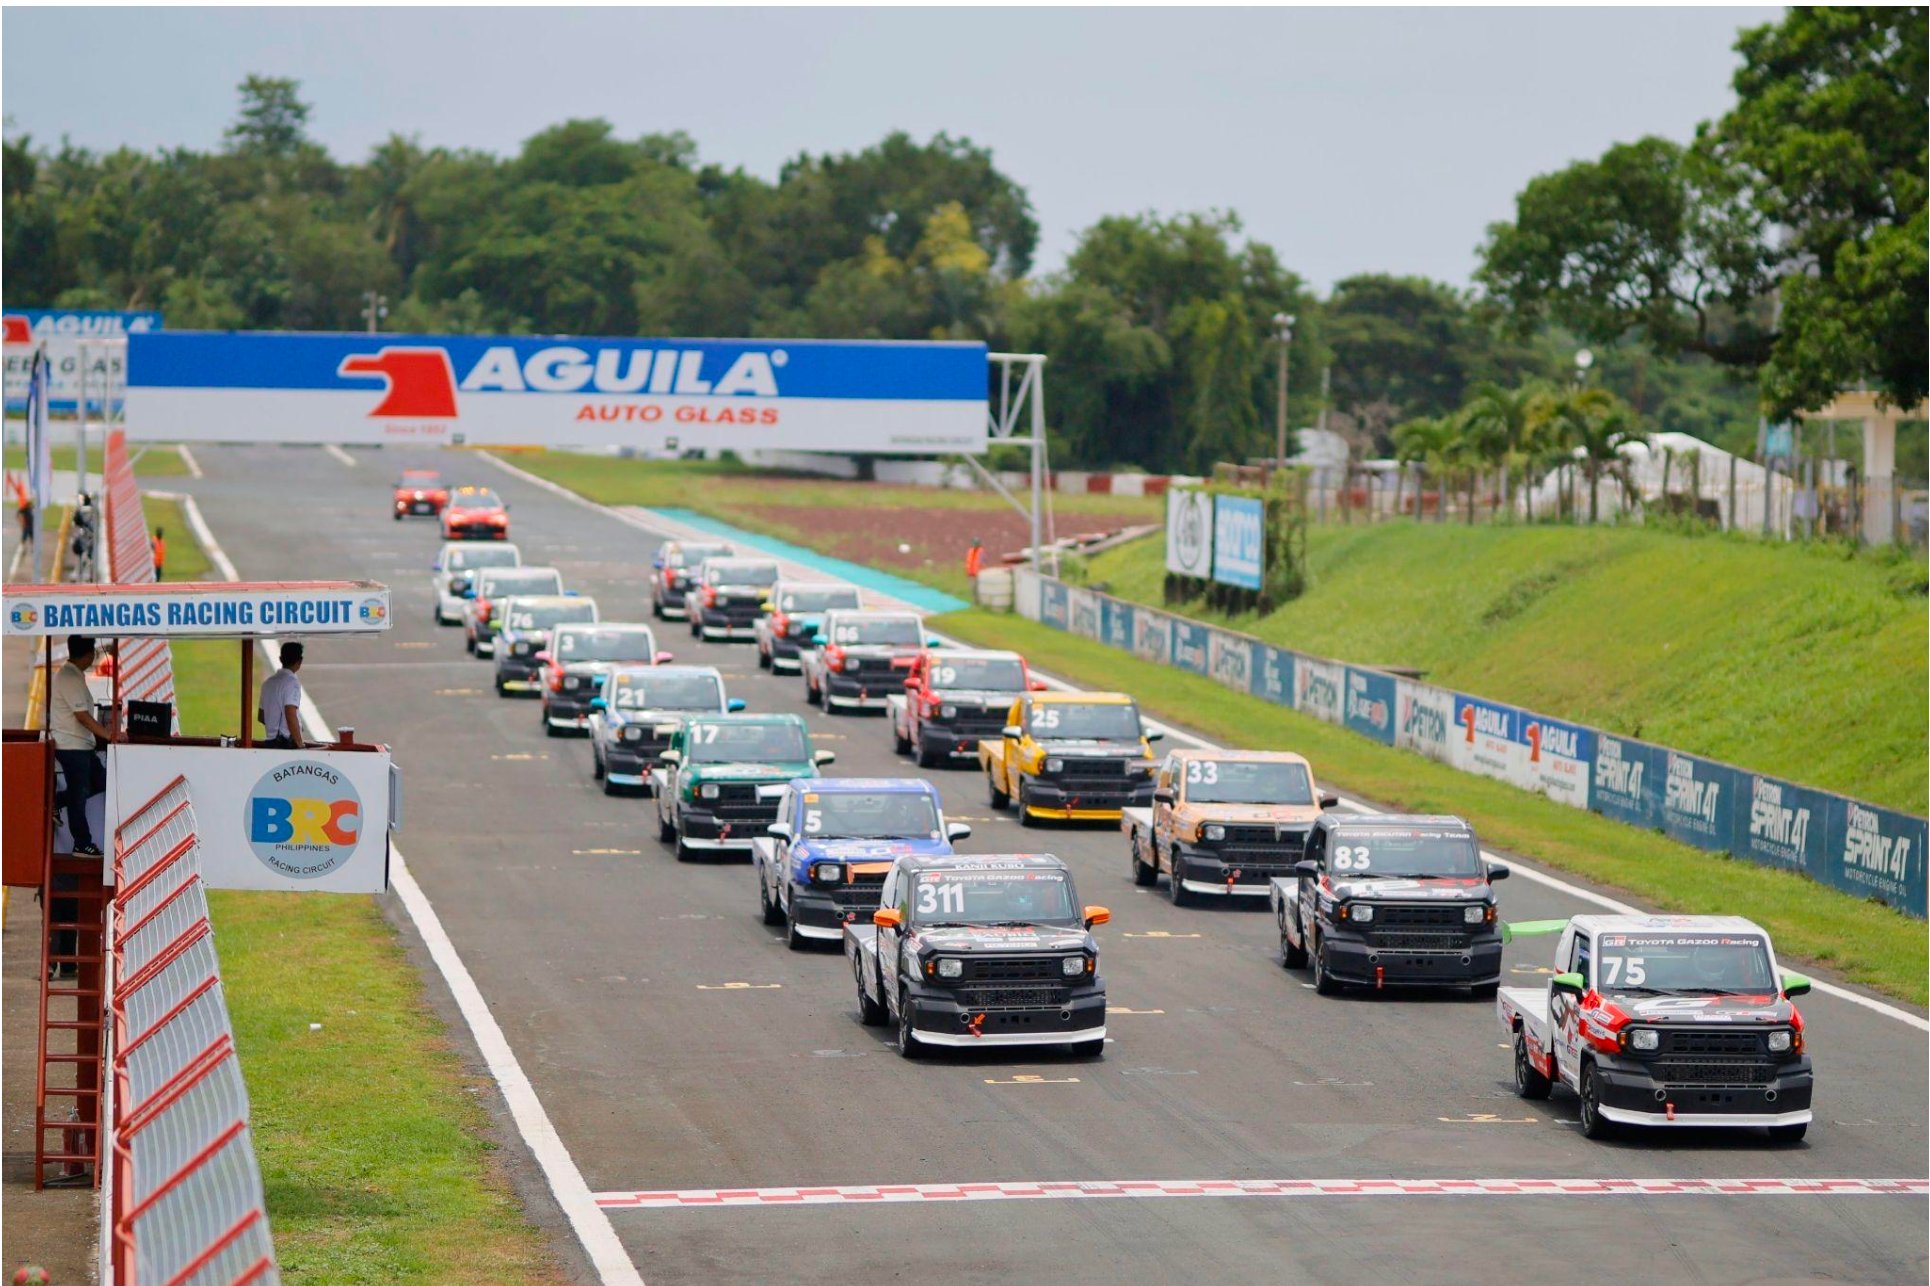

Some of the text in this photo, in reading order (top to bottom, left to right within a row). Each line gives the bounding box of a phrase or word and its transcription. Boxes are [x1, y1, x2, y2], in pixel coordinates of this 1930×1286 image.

[33, 314, 150, 333] AGUILA
[459, 346, 778, 396] AGUILA
[576, 405, 779, 426] AUTO GLASS
[484, 582, 495, 595] 7
[44, 603, 162, 628] BATANGAS
[168, 602, 253, 626] RACING
[260, 600, 353, 625] CIRCUIT
[511, 612, 534, 629] 76
[561, 635, 574, 651] 3
[836, 625, 859, 641] 86
[931, 667, 957, 685] 19
[617, 688, 646, 706] 21
[133, 713, 159, 724] PIAA
[1031, 709, 1060, 729] 25
[1475, 706, 1509, 739] AGUILA
[690, 725, 720, 745] 17
[1541, 724, 1578, 758] AGUILA
[272, 765, 339, 785] BATANGAS
[1187, 760, 1218, 785] 33
[1595, 754, 1630, 793] SPRINT
[1628, 760, 1644, 800] 4T
[1665, 774, 1704, 815] SPRINT
[1702, 780, 1720, 823] 4T
[251, 797, 359, 846] BRC
[804, 810, 822, 833] 5
[1750, 799, 1811, 854] SPRINT 4T
[275, 844, 331, 853] PHILIPPINES
[1334, 845, 1371, 870] 83
[1843, 827, 1911, 882] SPRINT 4T
[268, 856, 336, 875] RACING CIRCUIT
[1844, 867, 1907, 898] MOTORCYCLE ENGINE OIL
[917, 882, 965, 914] 311
[1603, 936, 1626, 947] GR
[1677, 938, 1719, 946] GAZOO
[1720, 937, 1760, 947] Racing
[1601, 956, 1646, 986] 75
